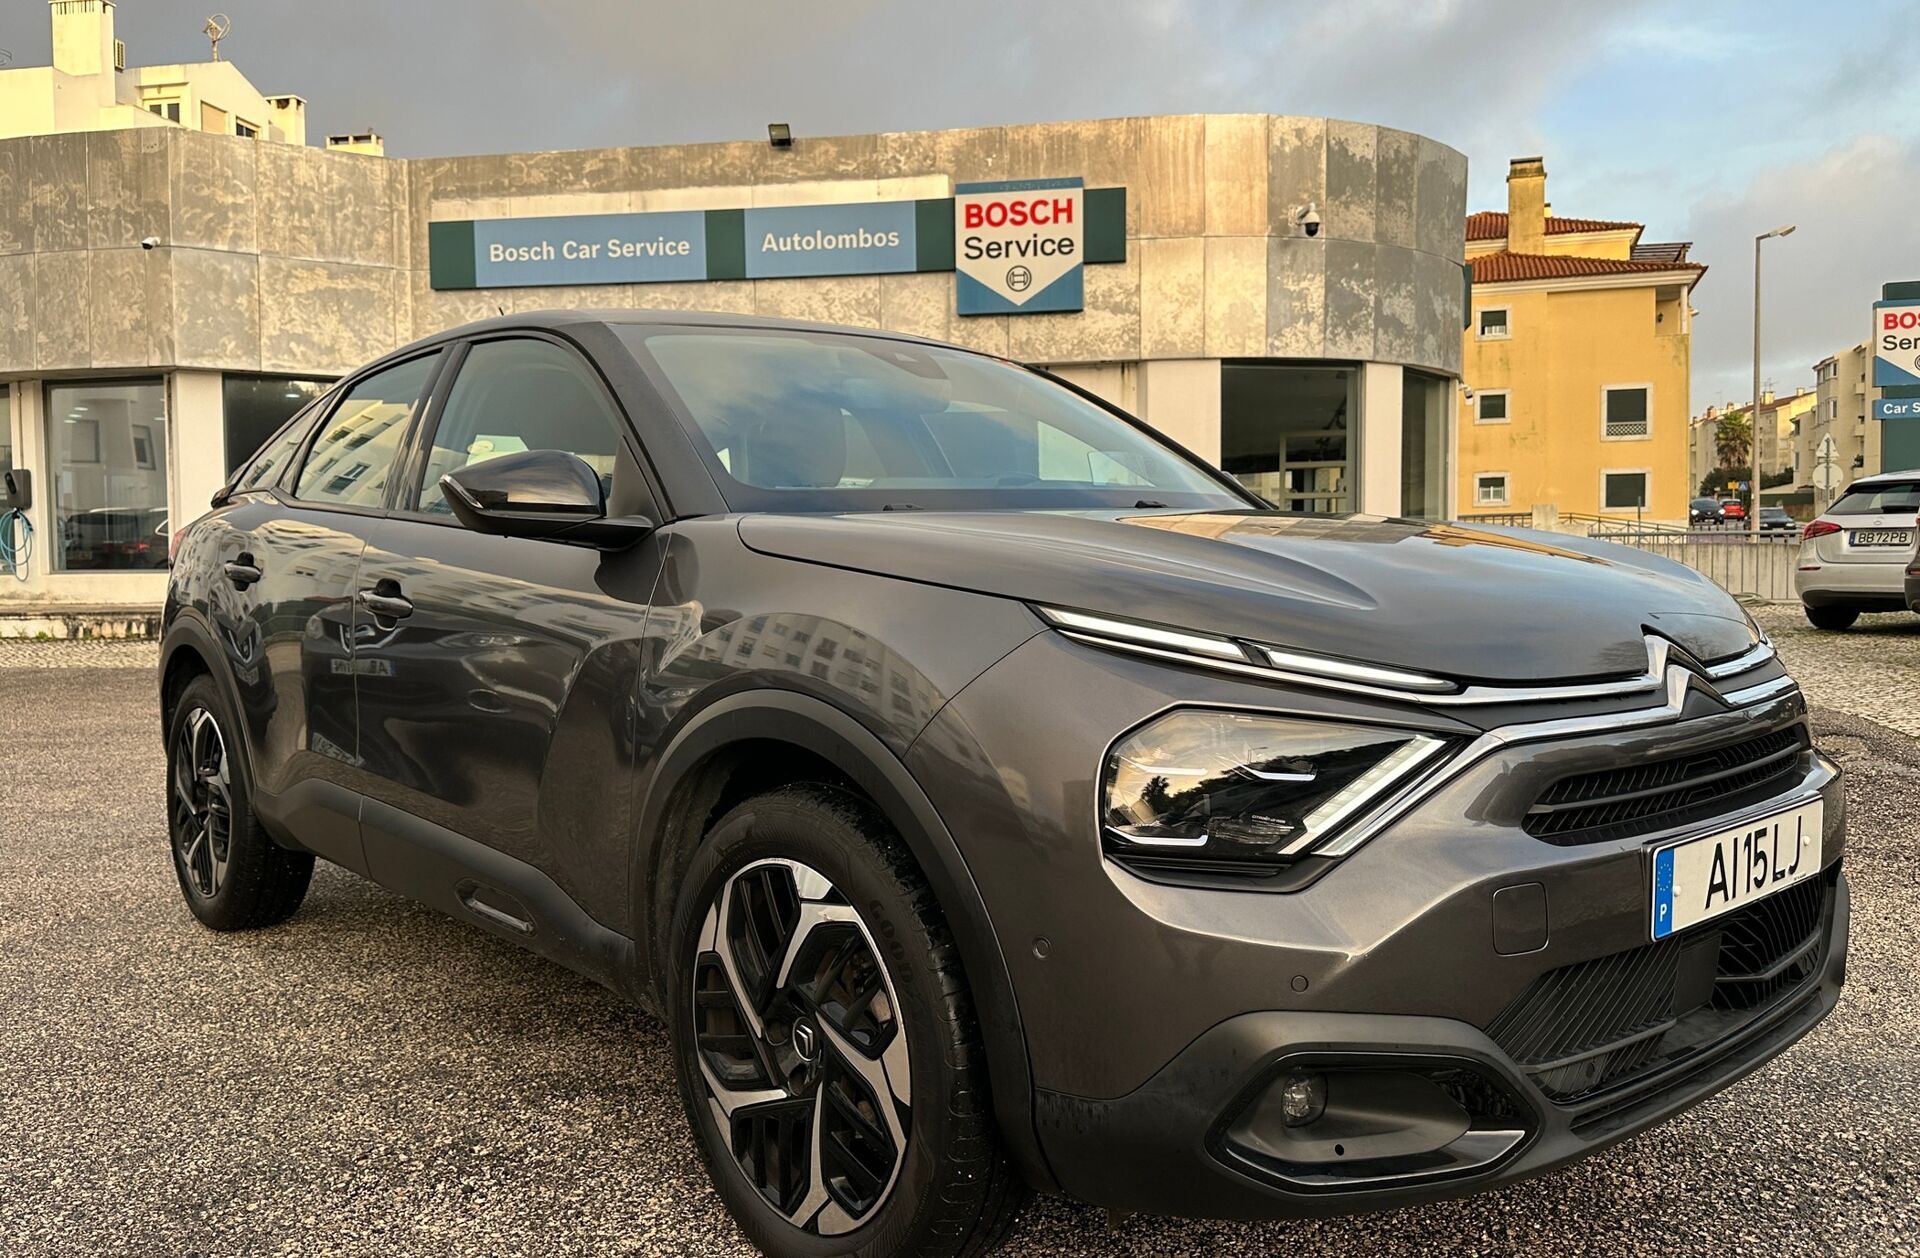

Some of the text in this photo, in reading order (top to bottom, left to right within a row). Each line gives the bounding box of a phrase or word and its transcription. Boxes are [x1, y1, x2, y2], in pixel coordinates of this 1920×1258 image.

[965, 198, 1073, 229] BOSCH
[489, 236, 690, 262] Bosch Car Service
[762, 228, 900, 252] Autolombos
[964, 233, 1074, 260] Service
[1884, 312, 1920, 330] BO
[1883, 403, 1908, 415] Car
[1659, 903, 1668, 922] P
